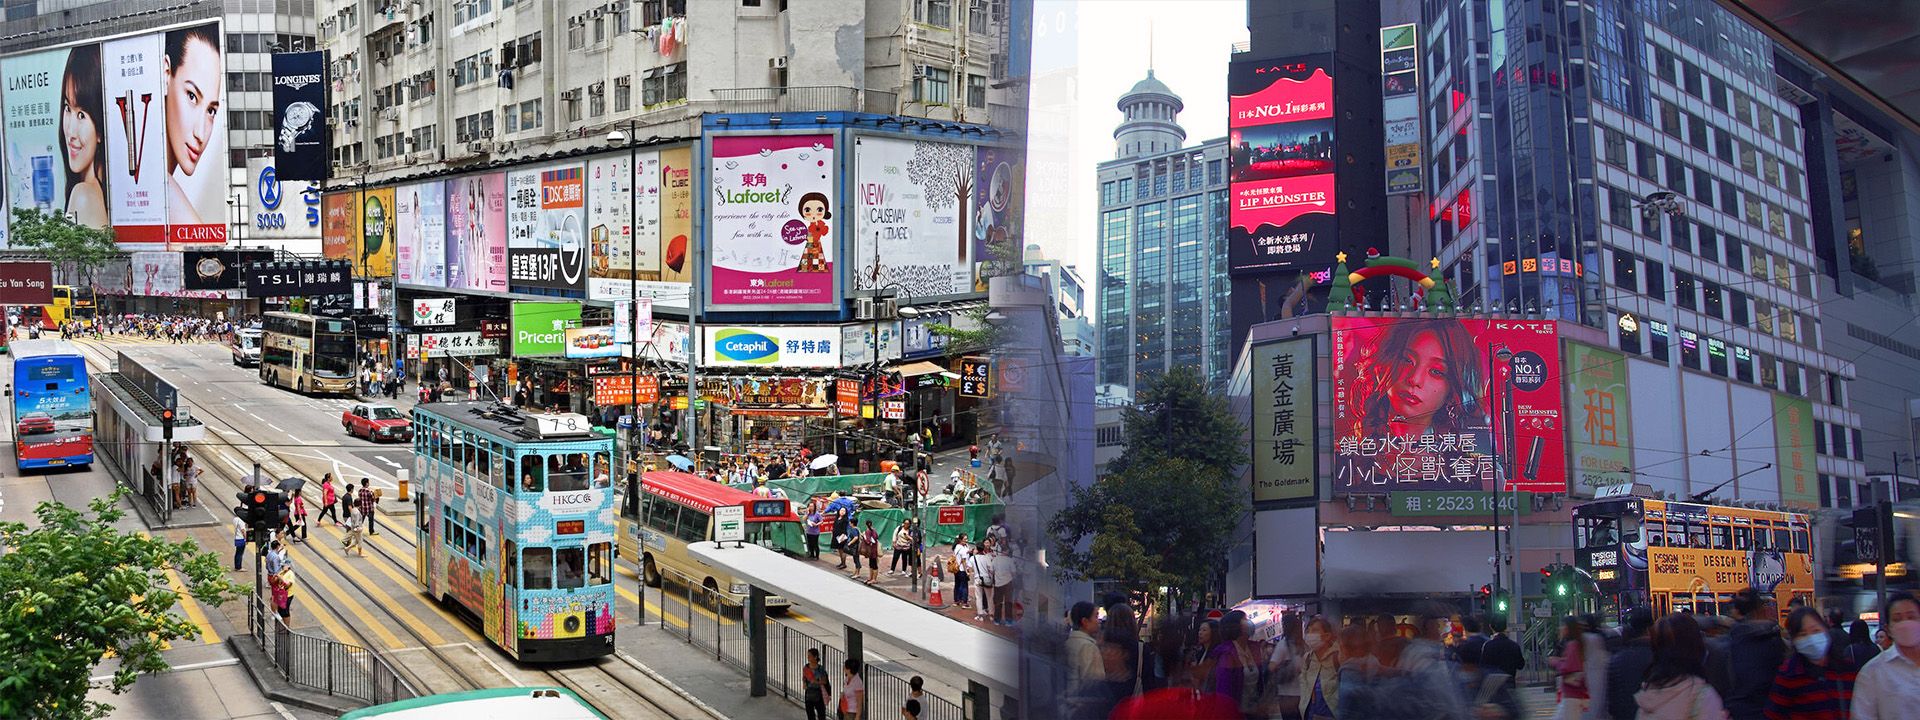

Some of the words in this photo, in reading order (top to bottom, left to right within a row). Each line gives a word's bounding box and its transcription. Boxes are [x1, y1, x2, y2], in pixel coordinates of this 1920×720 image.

[9, 72, 49, 91] LANEIGE
[275, 75, 320, 85] LONGINES
[672, 168, 688, 178] home
[742, 173, 768, 188] 東角
[727, 189, 780, 204] Laforet
[861, 184, 886, 206] NEW
[1240, 198, 1260, 208] LIP
[1262, 192, 1326, 206] MONSTER
[257, 213, 286, 230] SOGO
[714, 213, 746, 222] experience
[749, 211, 760, 220] the
[762, 212, 775, 221] city
[871, 208, 906, 224] CAUSEWAY
[177, 227, 225, 240] CLARINS
[731, 229, 746, 240] fun
[1258, 233, 1308, 246] 全新水光系列
[512, 253, 558, 282] 皇室堡13/F
[258, 275, 295, 285] TSL
[304, 272, 341, 284] 謝瑞麟
[1309, 267, 1331, 284] xgd
[10, 279, 24, 288] Yan
[27, 279, 45, 290] Sang
[486, 323, 508, 331] 周大福
[519, 331, 566, 344] Pricerit
[726, 341, 768, 354] Cetaphil
[786, 340, 822, 354] 舒特膚
[964, 364, 974, 376] ¥
[977, 364, 986, 376] €
[1515, 364, 1541, 374] NO.1
[964, 382, 973, 394] £
[977, 383, 986, 395] $
[1272, 353, 1295, 466] 黃金廣場
[550, 418, 577, 432] 78
[1583, 389, 1618, 448] 租
[1338, 433, 1478, 458] 鎖色水光果凍唇
[1338, 453, 1502, 487] 小心怪獸奪唇
[1581, 456, 1598, 470] FOR
[1599, 459, 1625, 472] LEASE
[1274, 477, 1310, 488] Goldmark
[1606, 486, 1624, 496] 141
[1436, 497, 1475, 511] 2523
[1481, 496, 1516, 511] 1840
[1591, 551, 1617, 560] DESIGN
[1654, 553, 1679, 563] DESIGN
[1591, 558, 1618, 567] INSPIRE
[1655, 564, 1680, 574] INSPIRE
[1704, 556, 1736, 568] DESIGN
[1763, 558, 1768, 569] A
[1716, 572, 1749, 584] BETTER
[1756, 572, 1795, 584] TOMORROW
